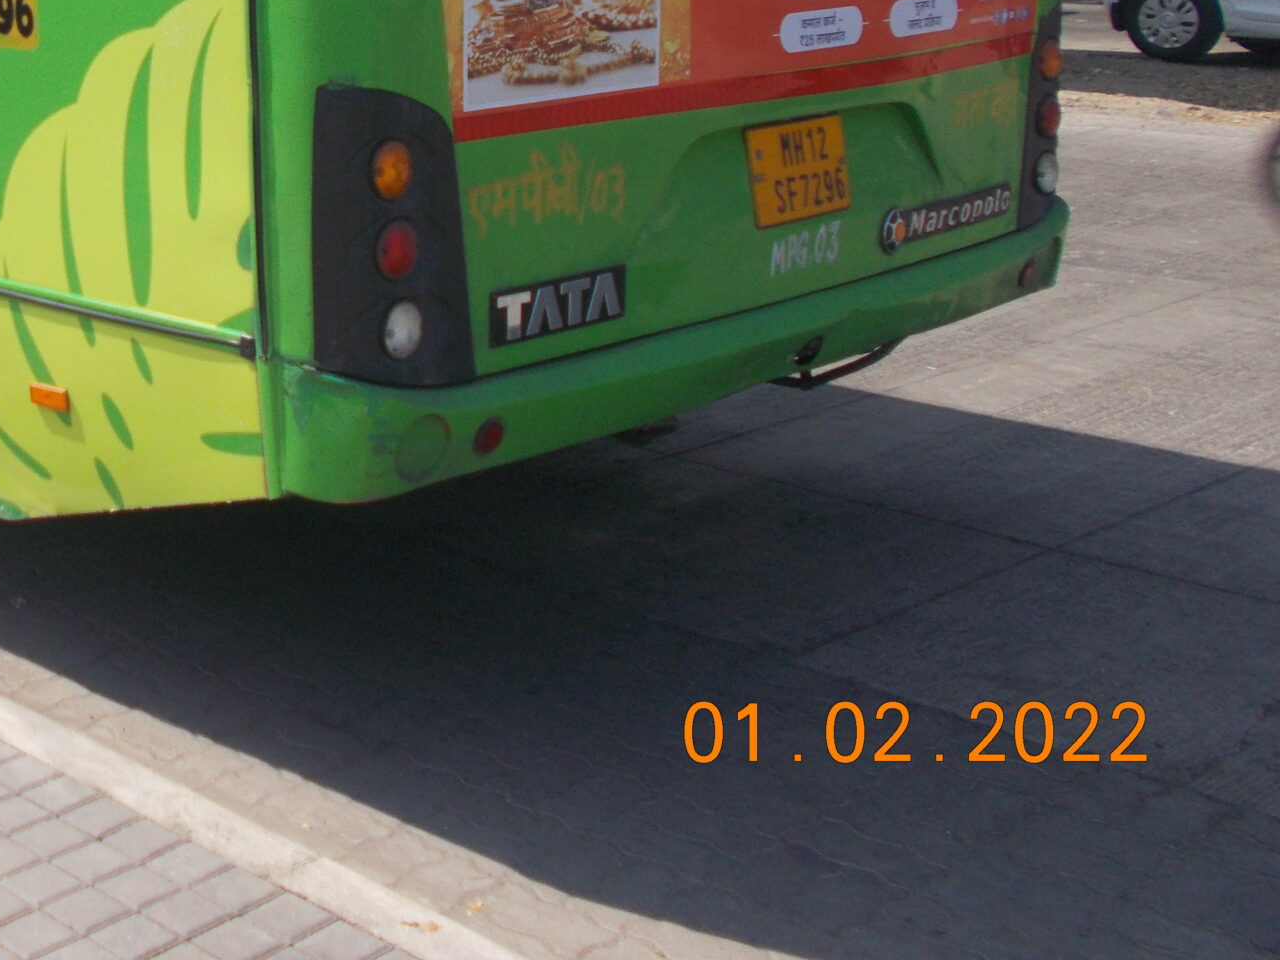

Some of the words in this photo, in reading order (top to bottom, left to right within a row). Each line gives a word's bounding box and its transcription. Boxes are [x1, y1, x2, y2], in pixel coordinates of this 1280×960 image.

[774, 166, 846, 214] SF7296
[907, 189, 1011, 238] Marcopolo
[496, 271, 621, 341] TATA
